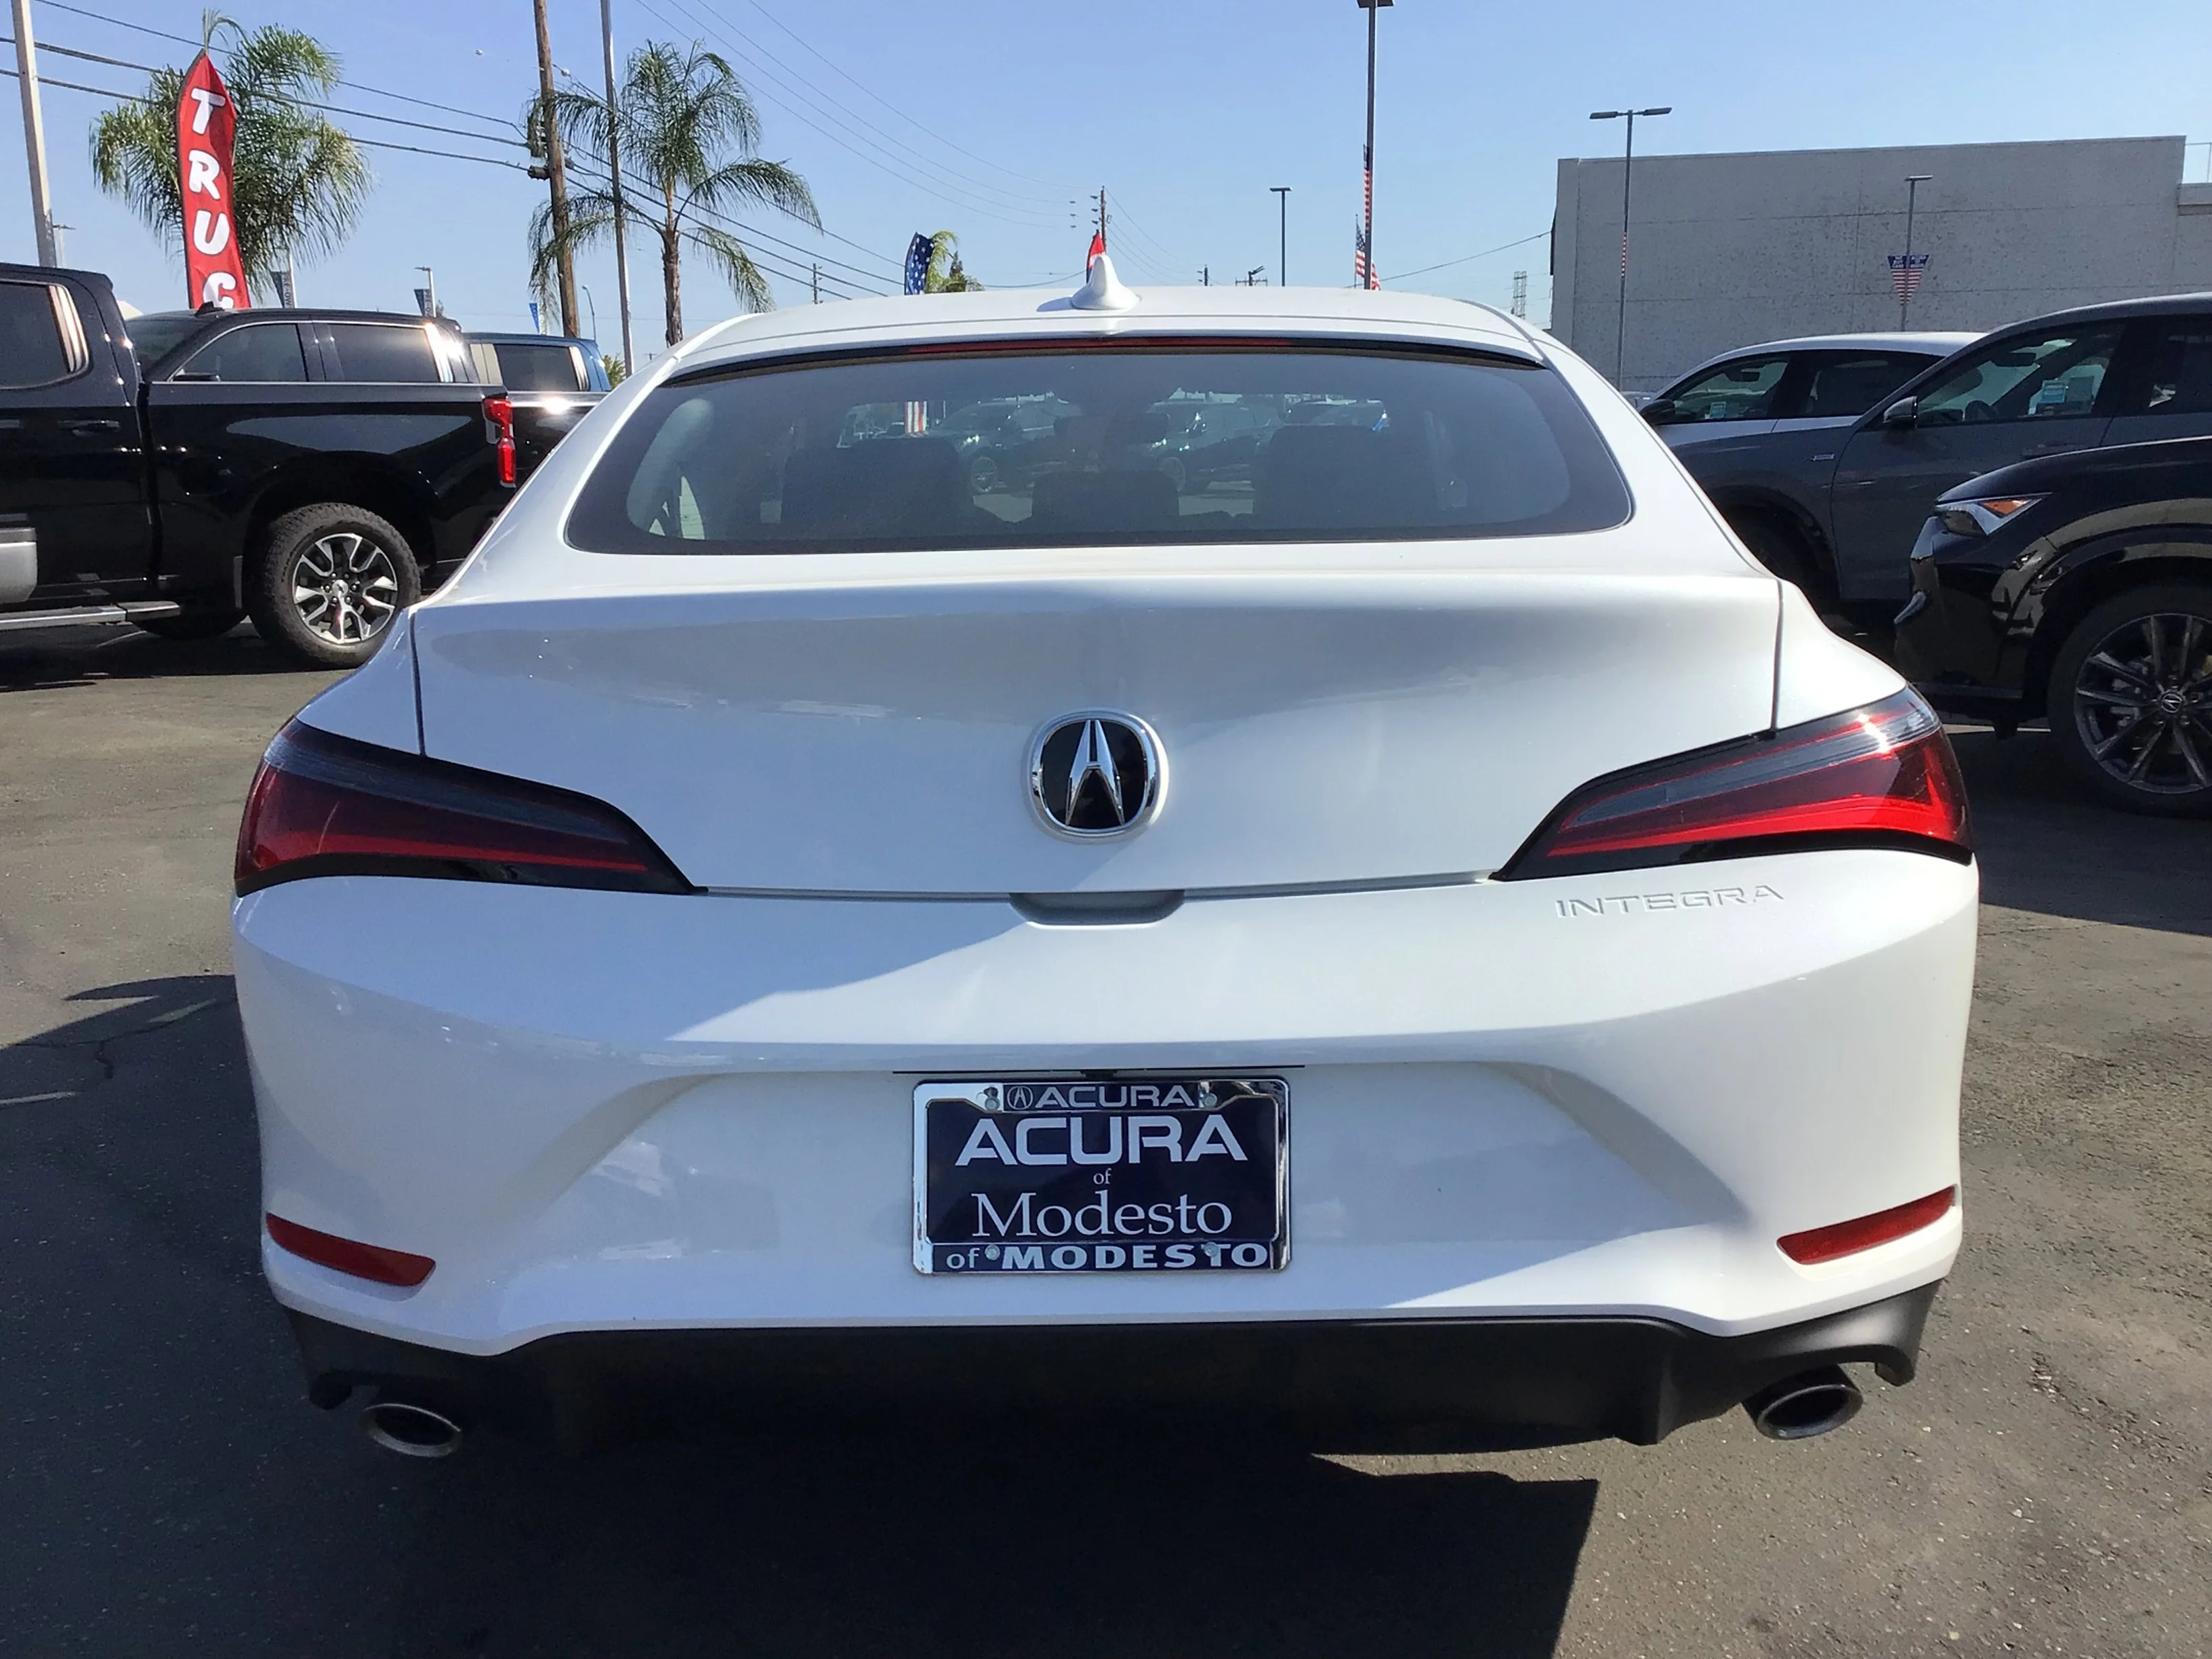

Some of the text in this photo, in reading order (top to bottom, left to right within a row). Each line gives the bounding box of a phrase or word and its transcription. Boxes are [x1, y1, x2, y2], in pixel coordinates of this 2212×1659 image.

[1555, 884, 1784, 918] INTEGRA
[1035, 1086, 1195, 1108] ACURA
[955, 1114, 1248, 1166] ACURA
[1093, 1168, 1112, 1185] of
[971, 1189, 1232, 1237] Modesto
[946, 1243, 1268, 1270] of MODESTO
